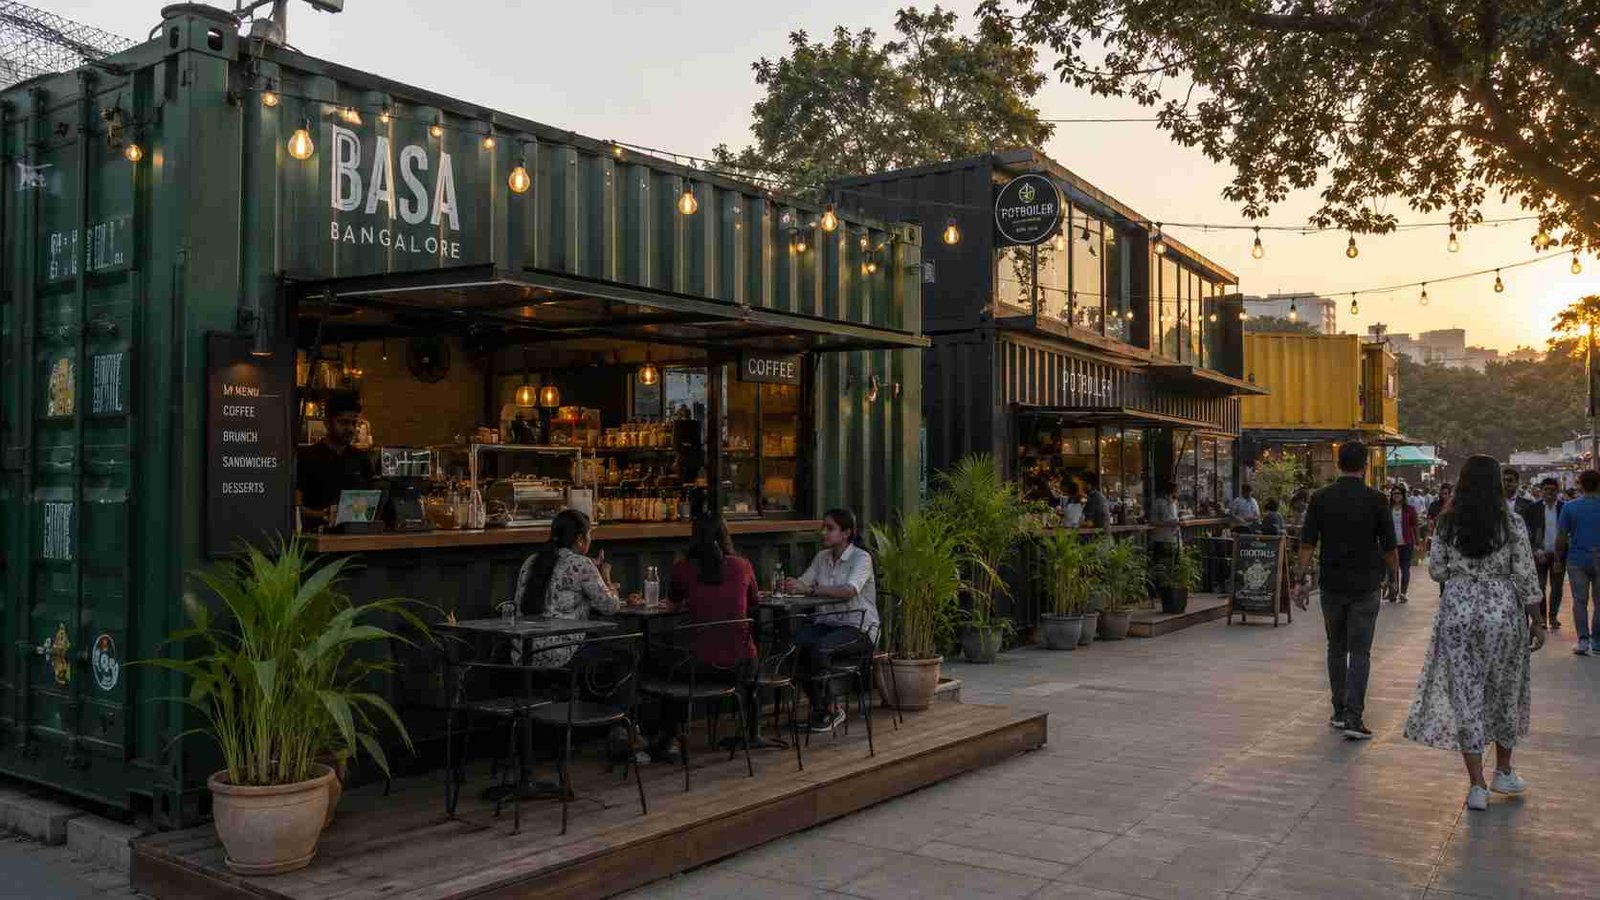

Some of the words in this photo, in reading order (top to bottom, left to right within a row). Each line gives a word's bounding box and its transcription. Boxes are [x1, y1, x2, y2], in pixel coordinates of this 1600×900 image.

[331, 124, 460, 231] BASA
[1001, 203, 1053, 219] POTBOILER
[330, 222, 460, 259] BANGALORE
[749, 358, 794, 378] COFFEE
[223, 405, 256, 418] COFFEE
[223, 430, 258, 443] BRUNCH
[222, 456, 277, 468] SANDWICHES
[222, 482, 265, 494] DESSERTS
